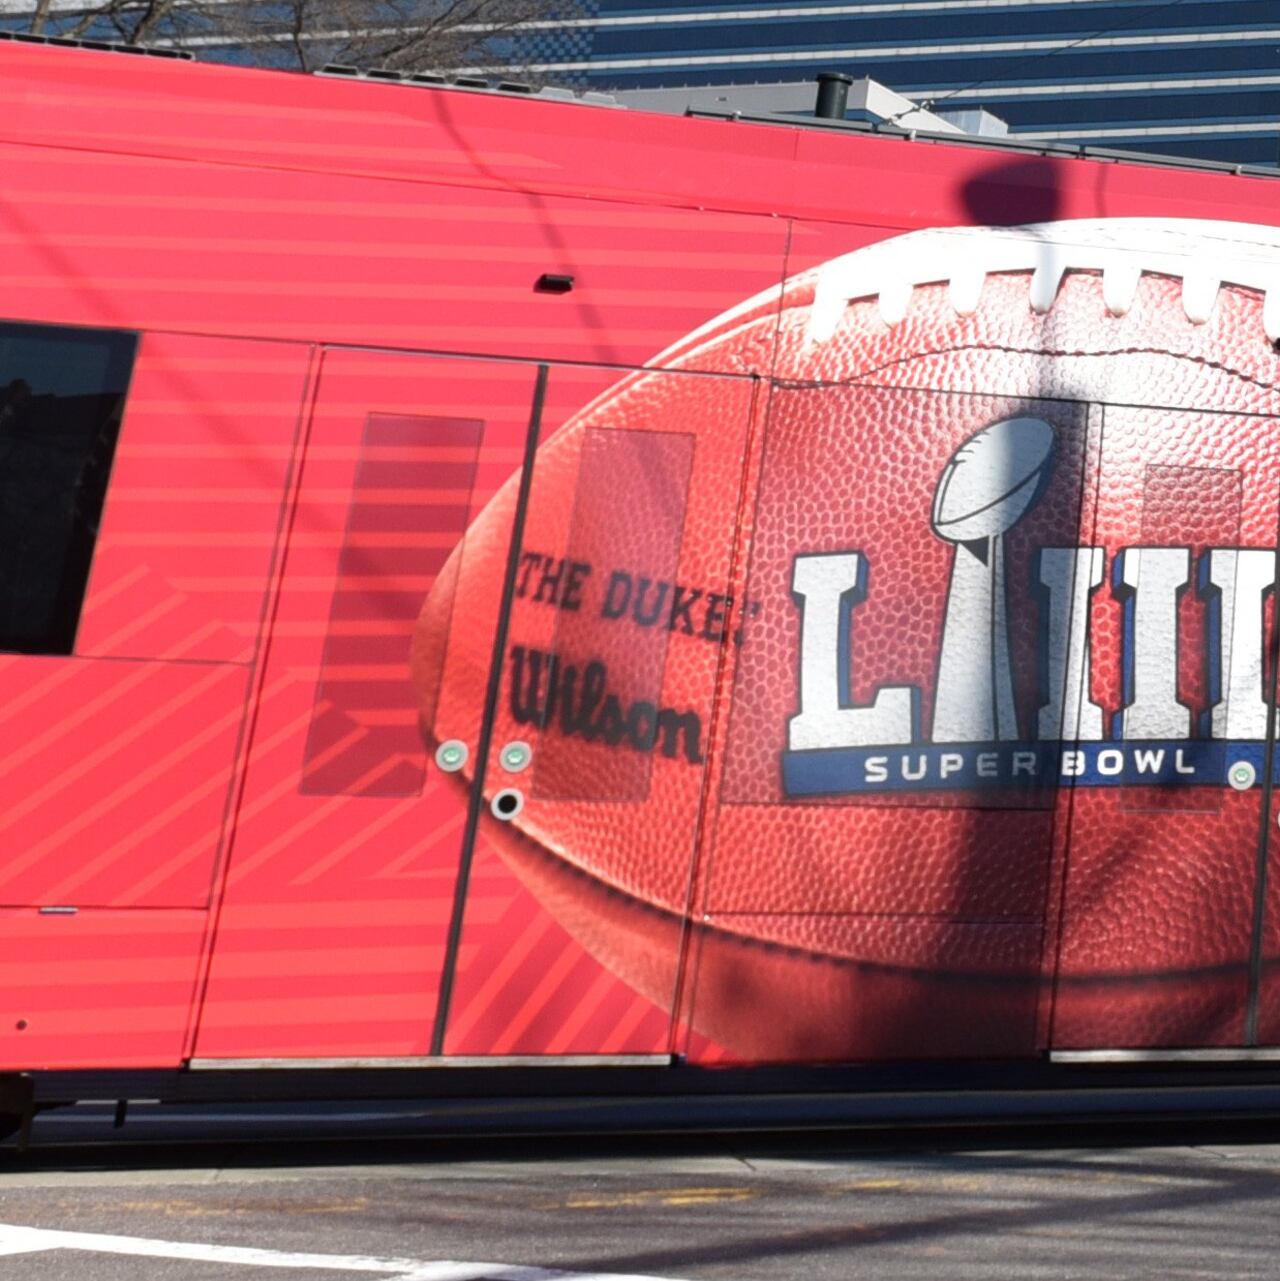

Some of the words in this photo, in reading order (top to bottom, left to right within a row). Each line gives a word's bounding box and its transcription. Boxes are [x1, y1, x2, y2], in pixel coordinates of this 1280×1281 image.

[515, 551, 592, 613] THE
[510, 644, 705, 765] Wilson
[864, 750, 1038, 783] SUPER
[1061, 748, 1196, 777] BOWL
